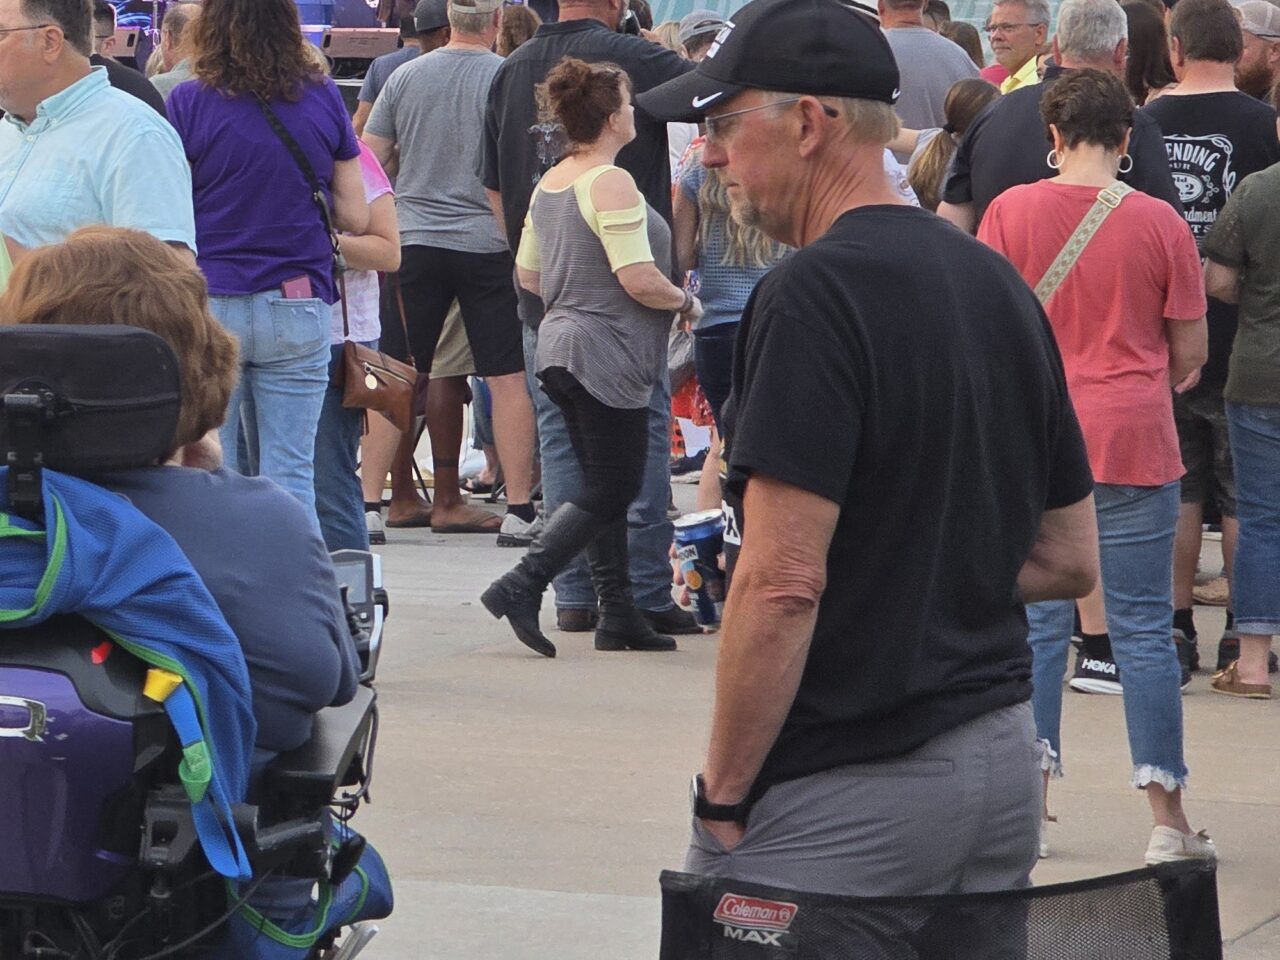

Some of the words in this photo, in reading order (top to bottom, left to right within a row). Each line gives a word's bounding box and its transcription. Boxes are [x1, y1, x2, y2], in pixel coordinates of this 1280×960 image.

[1165, 142, 1222, 172] ENDING
[1081, 658, 1116, 675] HOKA
[722, 898, 778, 920] Coleman
[723, 925, 782, 947] MAX
